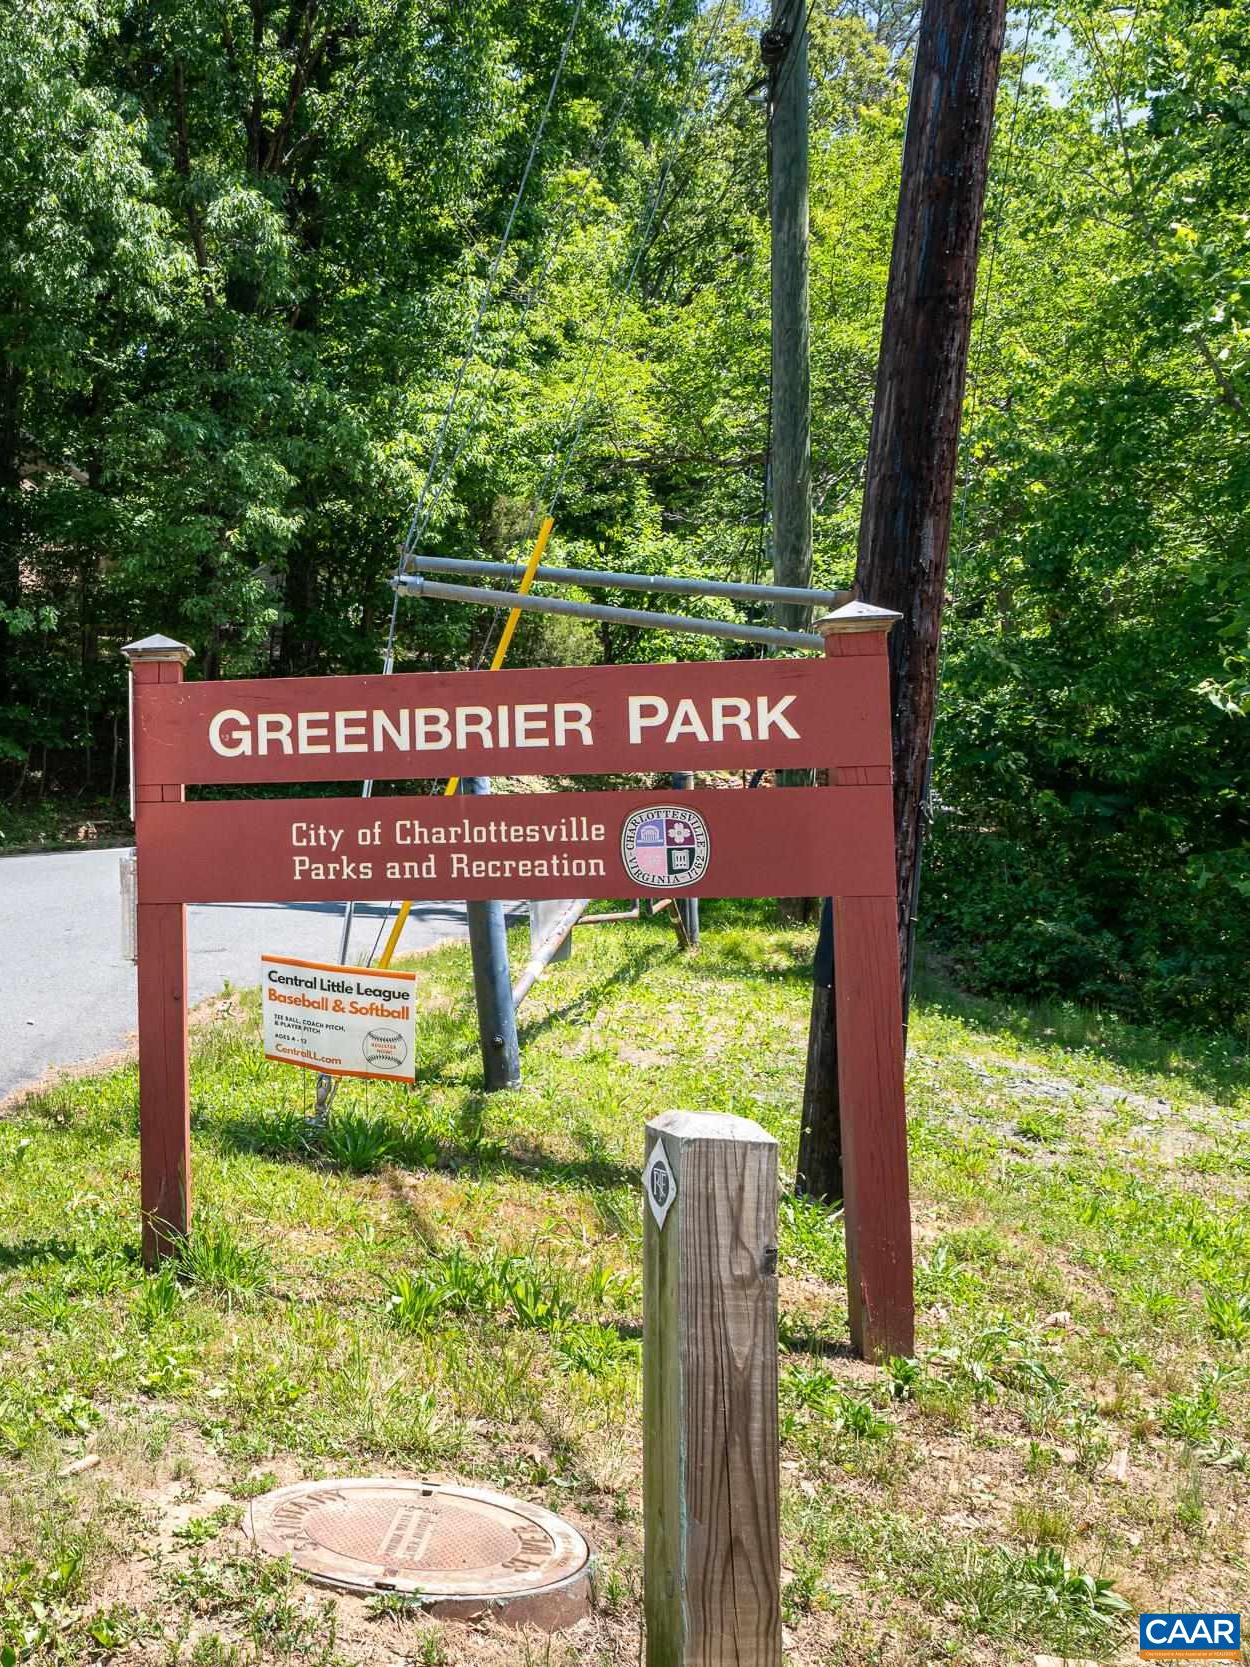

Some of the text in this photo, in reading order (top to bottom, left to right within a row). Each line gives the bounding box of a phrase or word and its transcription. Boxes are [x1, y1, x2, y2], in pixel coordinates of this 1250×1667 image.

[627, 695, 801, 744] PARK
[291, 816, 606, 852] City of Charlottesville
[625, 809, 706, 850] CHARLOTTESVILLE
[293, 853, 606, 880] Parks and Recreation
[628, 856, 681, 884] VIRGINIA
[267, 970, 410, 1002] Central Little League
[268, 988, 410, 1020] Baseball & Softball
[274, 1033, 290, 1041] AGES
[280, 1021, 302, 1030] PLAYER
[303, 1026, 321, 1034] PITCH
[302, 1019, 324, 1028] COACH
[325, 1024, 346, 1032] PITCH,
[275, 1043, 342, 1065] CentralLL.com
[272, 1490, 346, 1551] SANITARY
[501, 1525, 553, 1573] SEWER
